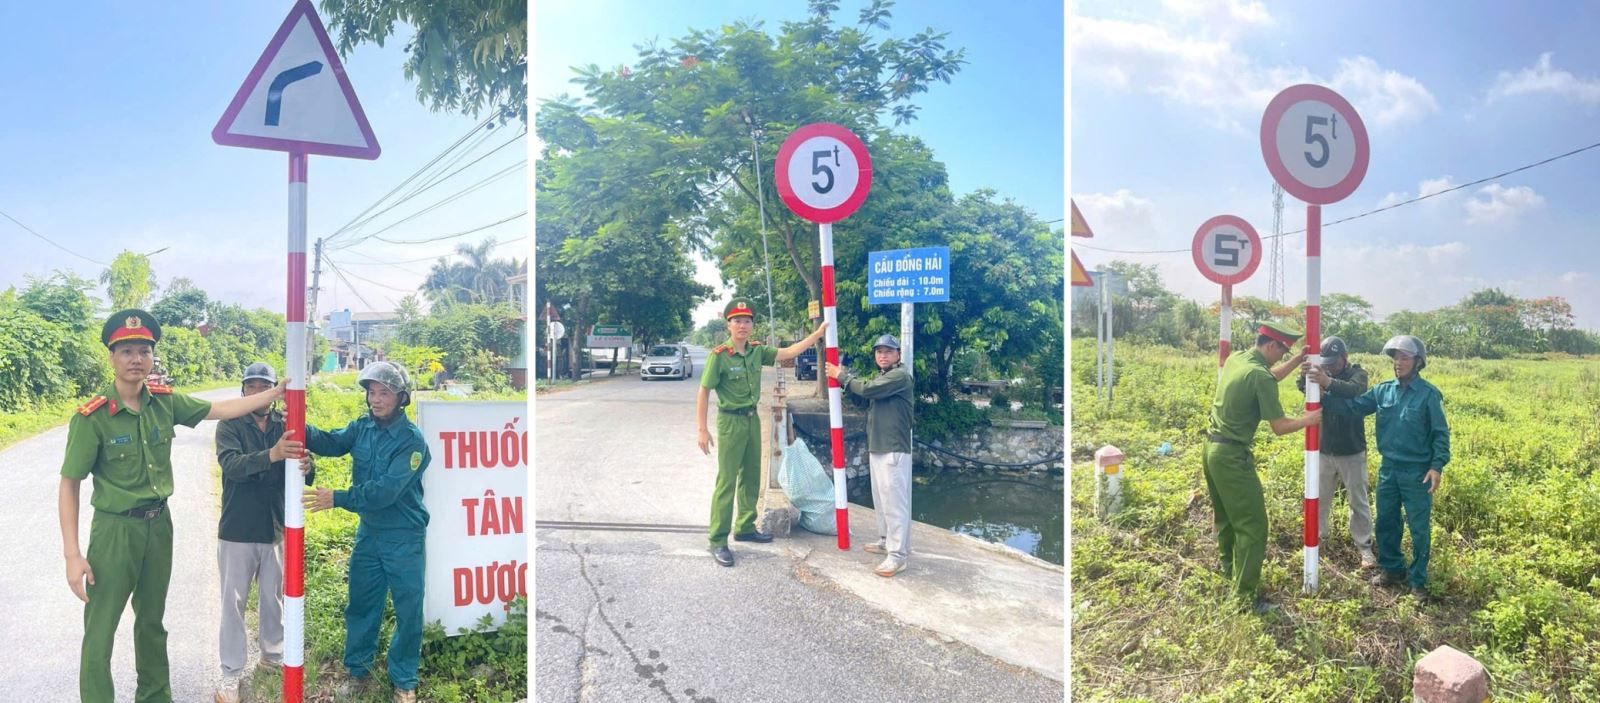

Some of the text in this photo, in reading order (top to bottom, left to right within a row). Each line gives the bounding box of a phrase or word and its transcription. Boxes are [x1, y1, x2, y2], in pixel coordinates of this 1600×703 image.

[895, 253, 922, 272] ĐỒNG
[925, 252, 942, 271] HẢI
[918, 275, 944, 286] 10.0m
[896, 287, 915, 298] rộng
[924, 287, 944, 296] 7.0m
[462, 489, 524, 537] TÂN
